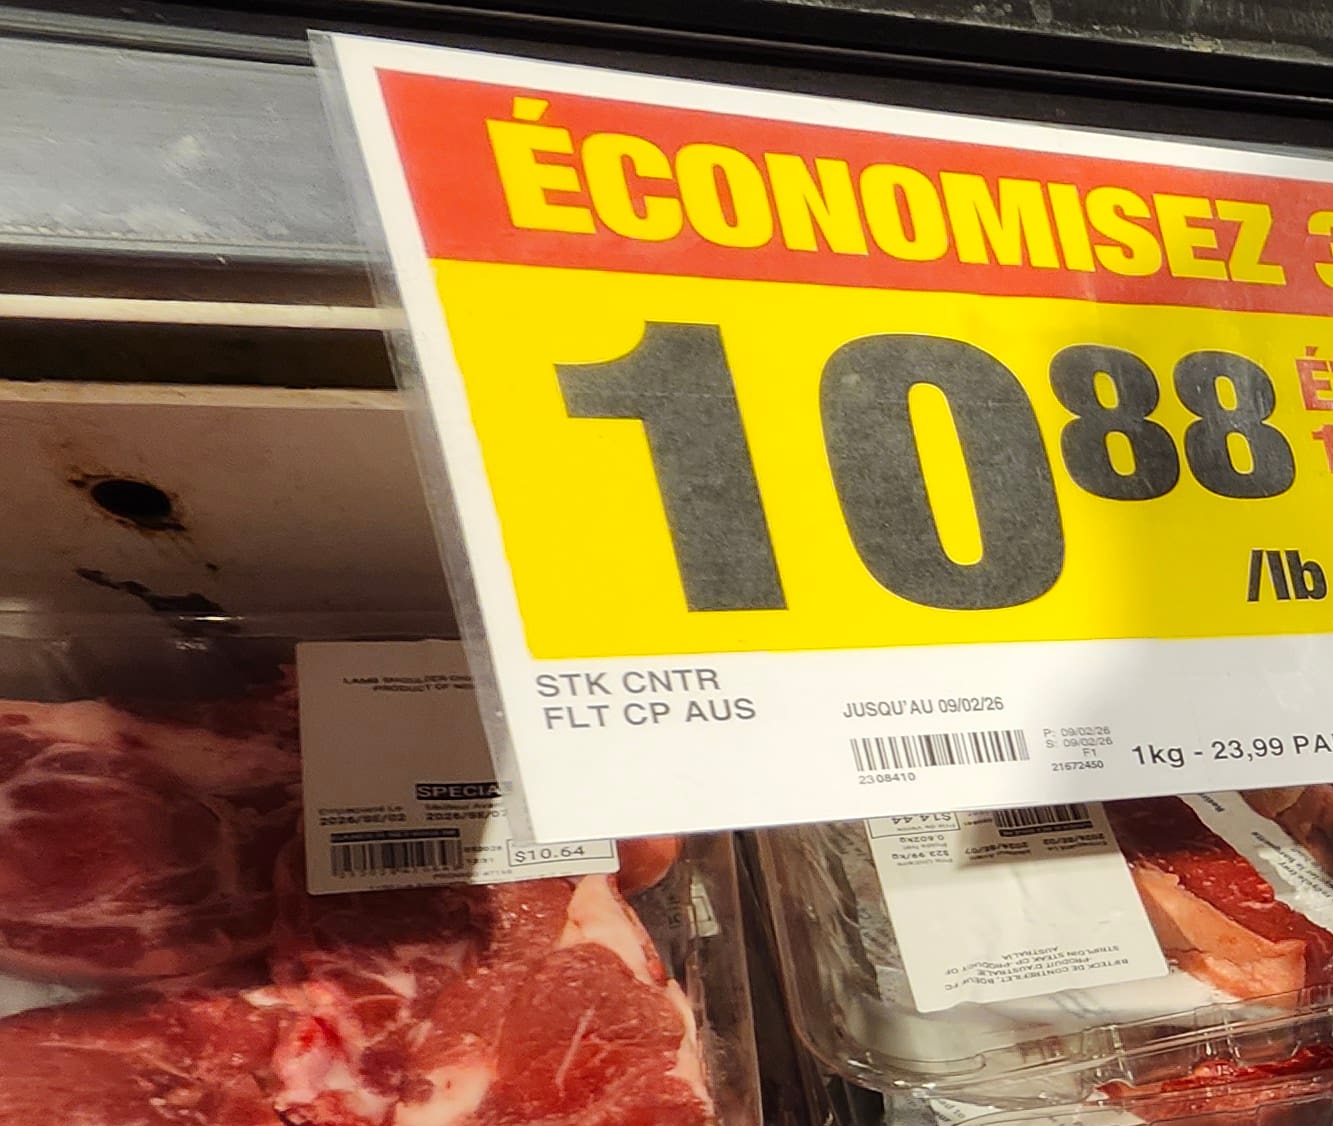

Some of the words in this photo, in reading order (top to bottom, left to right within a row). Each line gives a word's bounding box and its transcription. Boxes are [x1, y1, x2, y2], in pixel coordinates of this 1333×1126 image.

[486, 99, 1284, 286] ÉCONOMISEZ
[1246, 549, 1328, 604] /lb
[536, 671, 612, 699] STK
[622, 668, 721, 694] CNTR
[544, 704, 609, 730] FLT
[623, 702, 671, 725] CP
[685, 698, 756, 722] AUS
[843, 699, 934, 719] JUSQU'AU
[938, 695, 1004, 714] 09/02/26
[1132, 744, 1185, 769] 1kg
[1210, 738, 1285, 762] 23,99
[859, 771, 916, 785] 2308410
[515, 846, 585, 863] $10.64
